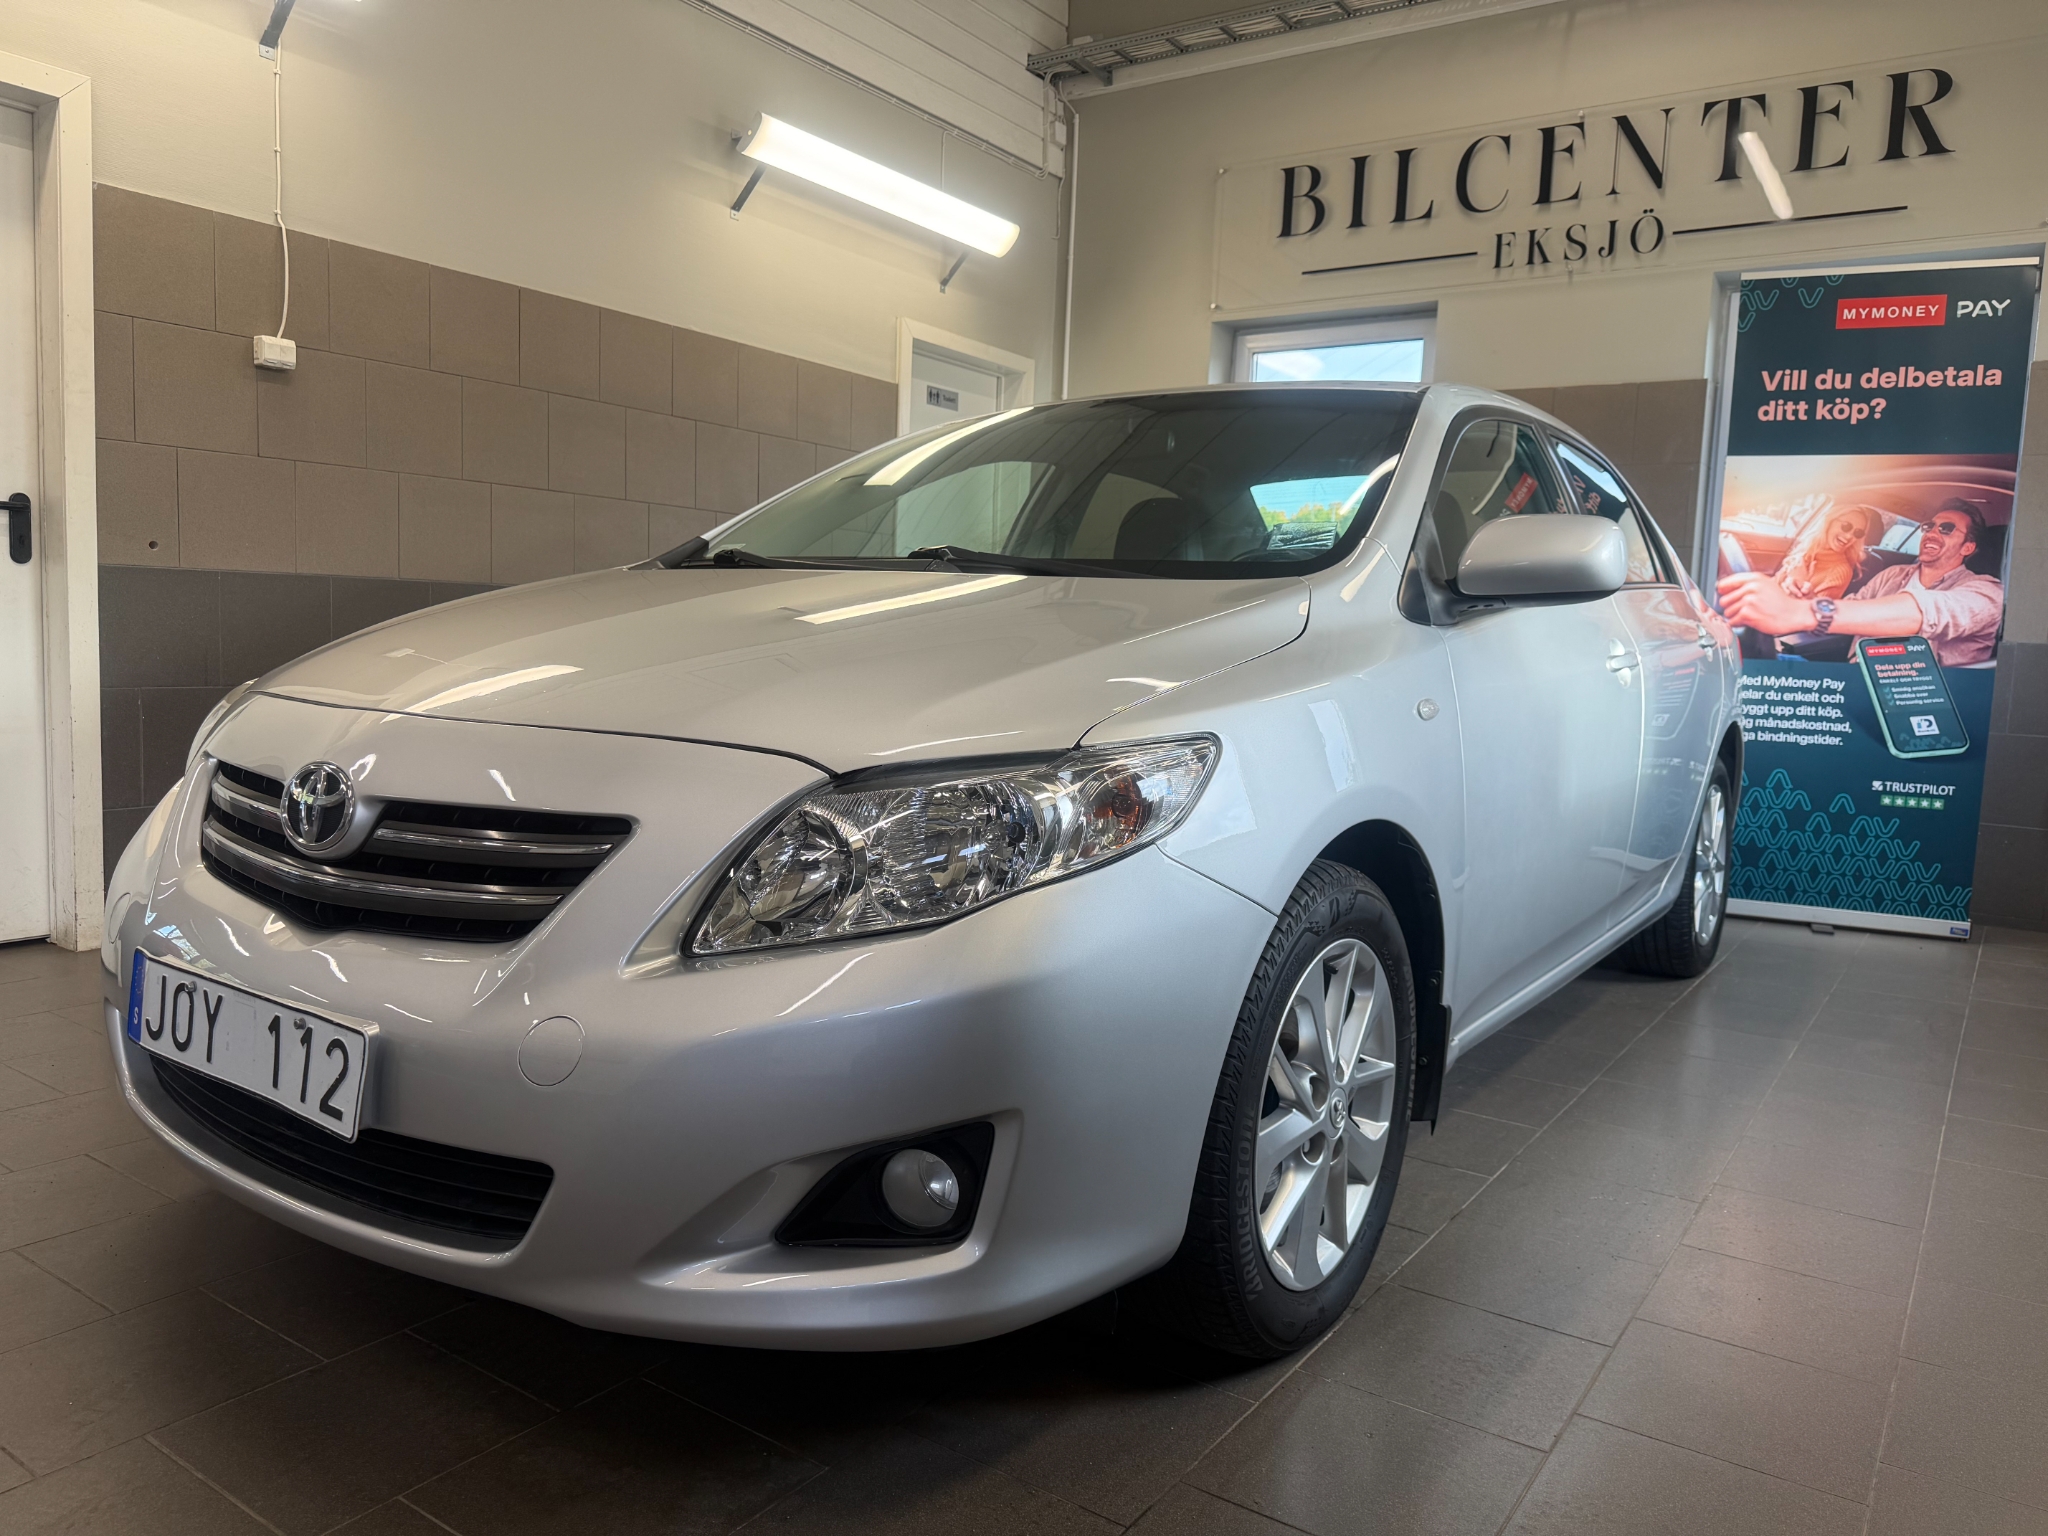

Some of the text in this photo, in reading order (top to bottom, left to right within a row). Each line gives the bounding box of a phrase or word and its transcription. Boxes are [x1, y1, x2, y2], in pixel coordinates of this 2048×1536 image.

[1276, 68, 1956, 239] BILCENTER
[1493, 209, 1665, 270] EKSJÖ
[1843, 299, 2011, 320] MYMONEY PAY
[1761, 364, 2002, 391] Vill du delbetala
[1757, 398, 1887, 425] ditt köp?
[1763, 675, 1821, 690] MyMoney
[1823, 678, 1845, 691] Pay
[1741, 689, 1845, 704] elar du enkelt och
[1770, 705, 1795, 717] upp
[1795, 705, 1817, 717] ditt
[1818, 706, 1844, 720] köp.
[1755, 717, 1853, 734] månadskostnad,
[1757, 730, 1844, 746] bindningstider.
[1884, 781, 1956, 796] TRUSTPILOT
[133, 1006, 139, 1025] S
[145, 974, 350, 1122] JOY 112
